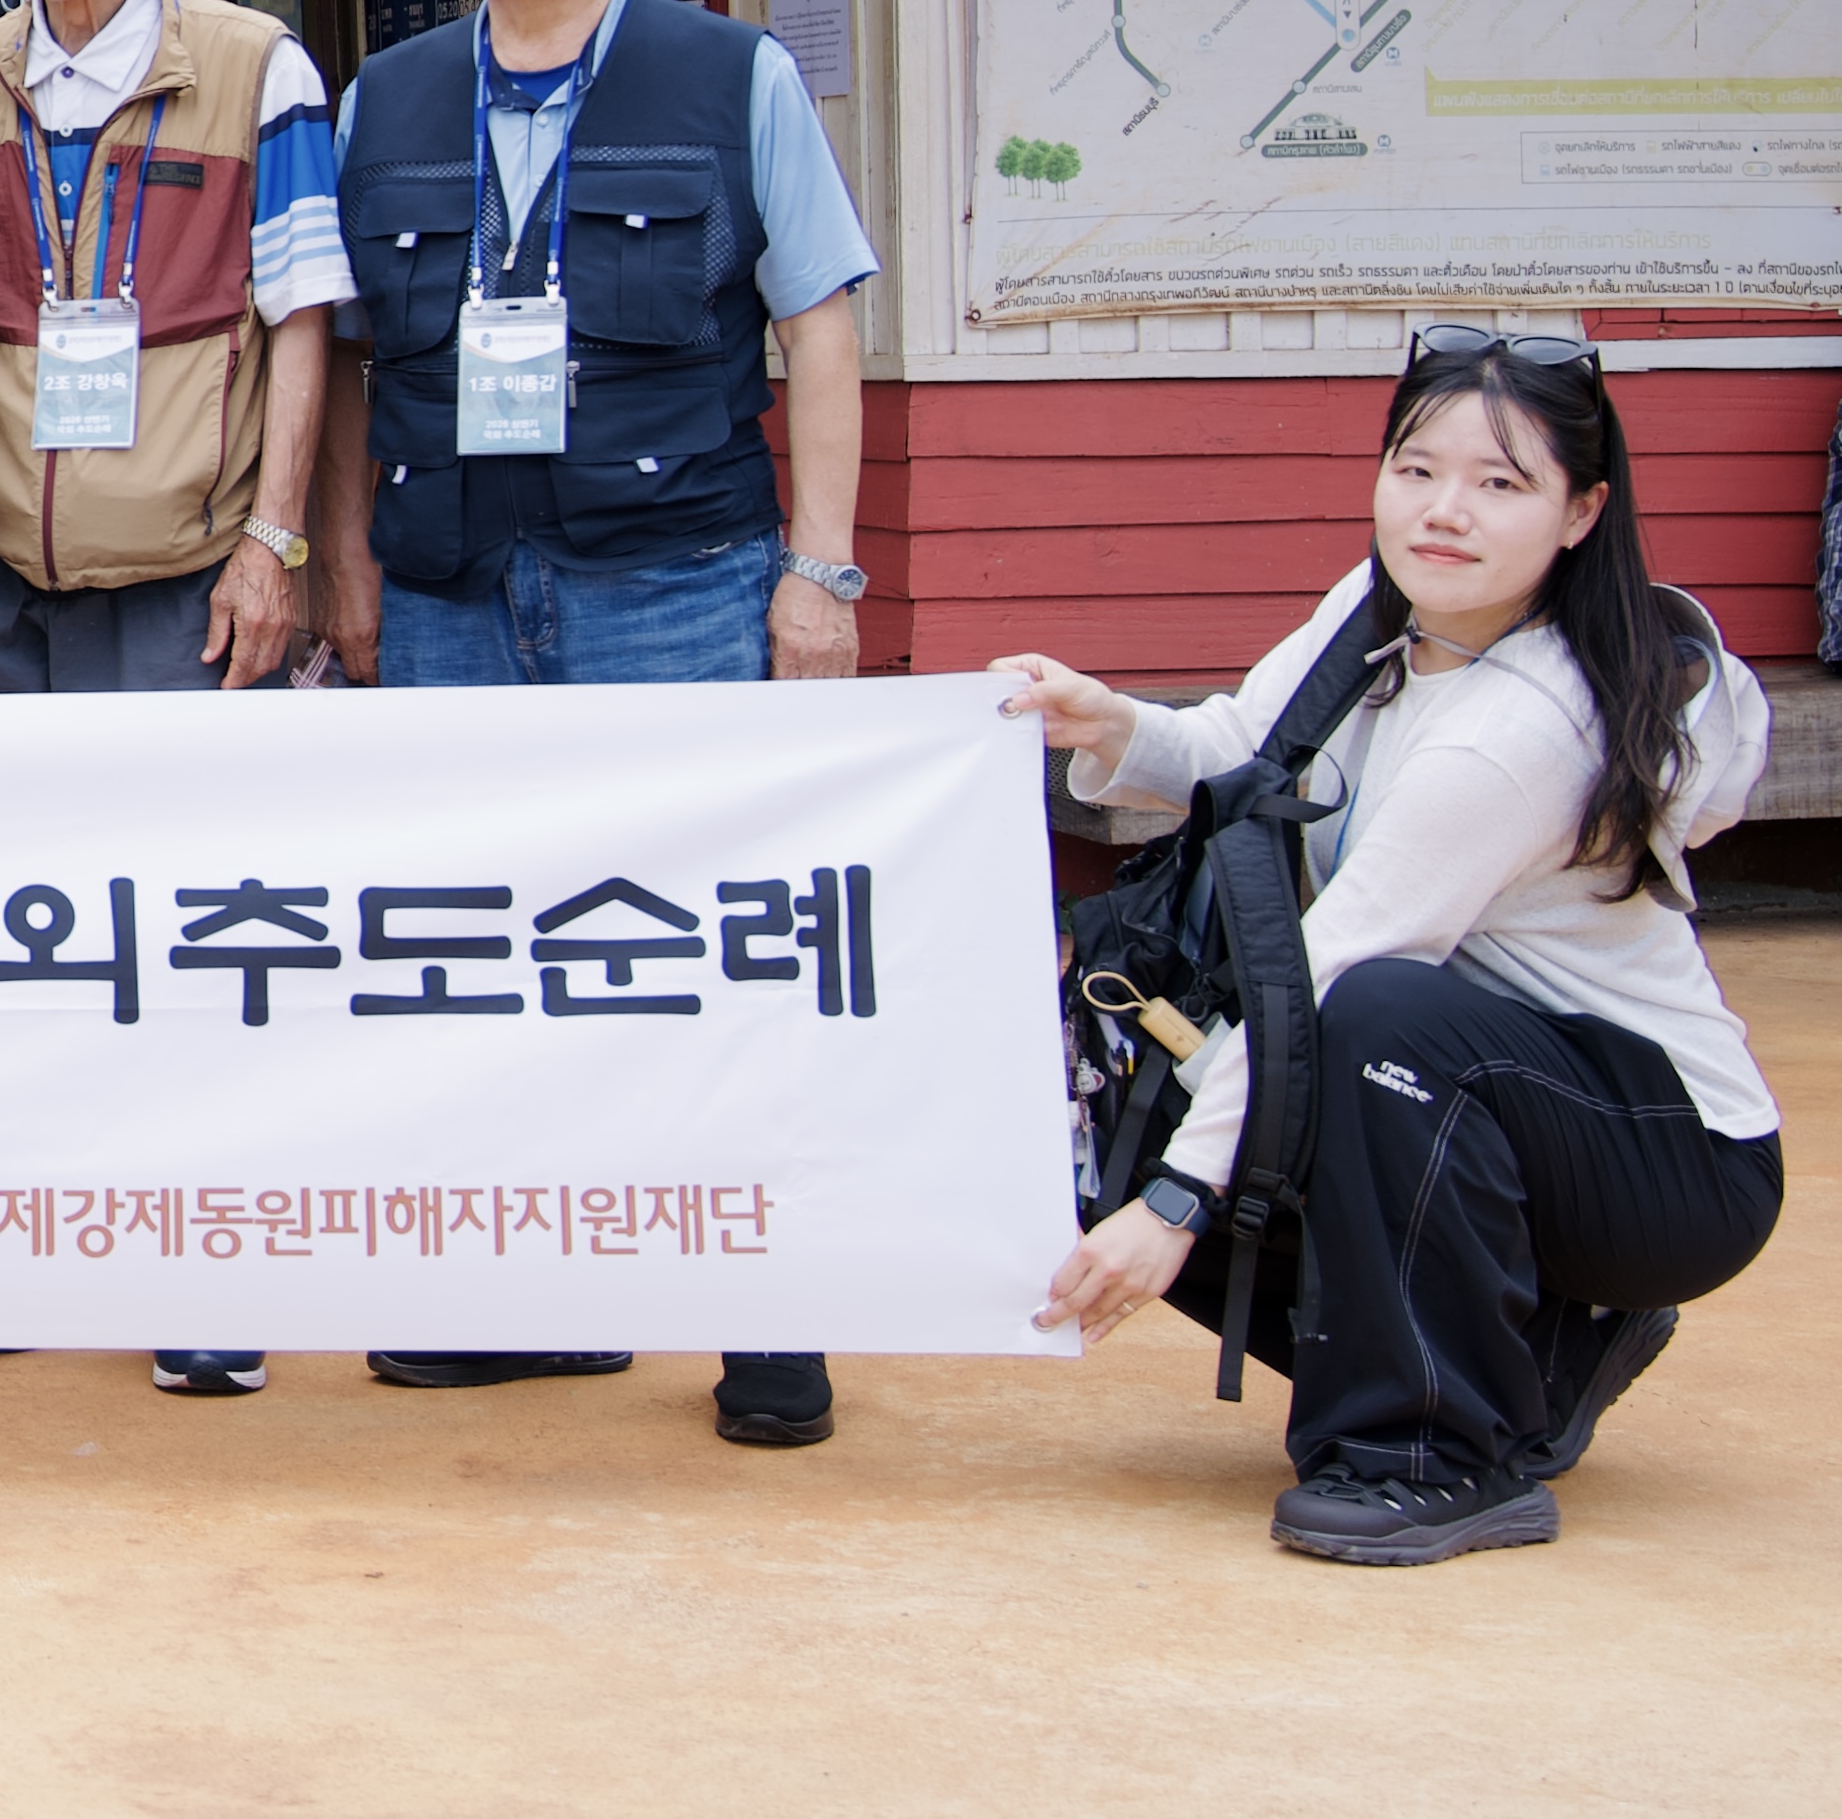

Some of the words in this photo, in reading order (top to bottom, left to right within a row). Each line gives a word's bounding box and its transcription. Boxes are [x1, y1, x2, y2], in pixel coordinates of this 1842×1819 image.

[1274, 264, 1315, 280] รถด่วน
[1318, 262, 1354, 280] รถเร็ว
[1357, 264, 1420, 280] รถธรรมดา
[1736, 263, 1755, 277] ลง
[42, 375, 72, 392] 2조
[467, 375, 498, 393] 1조
[502, 373, 558, 394] 이종갑
[1361, 1062, 1434, 1103] balance
[1379, 1060, 1418, 1084] new
